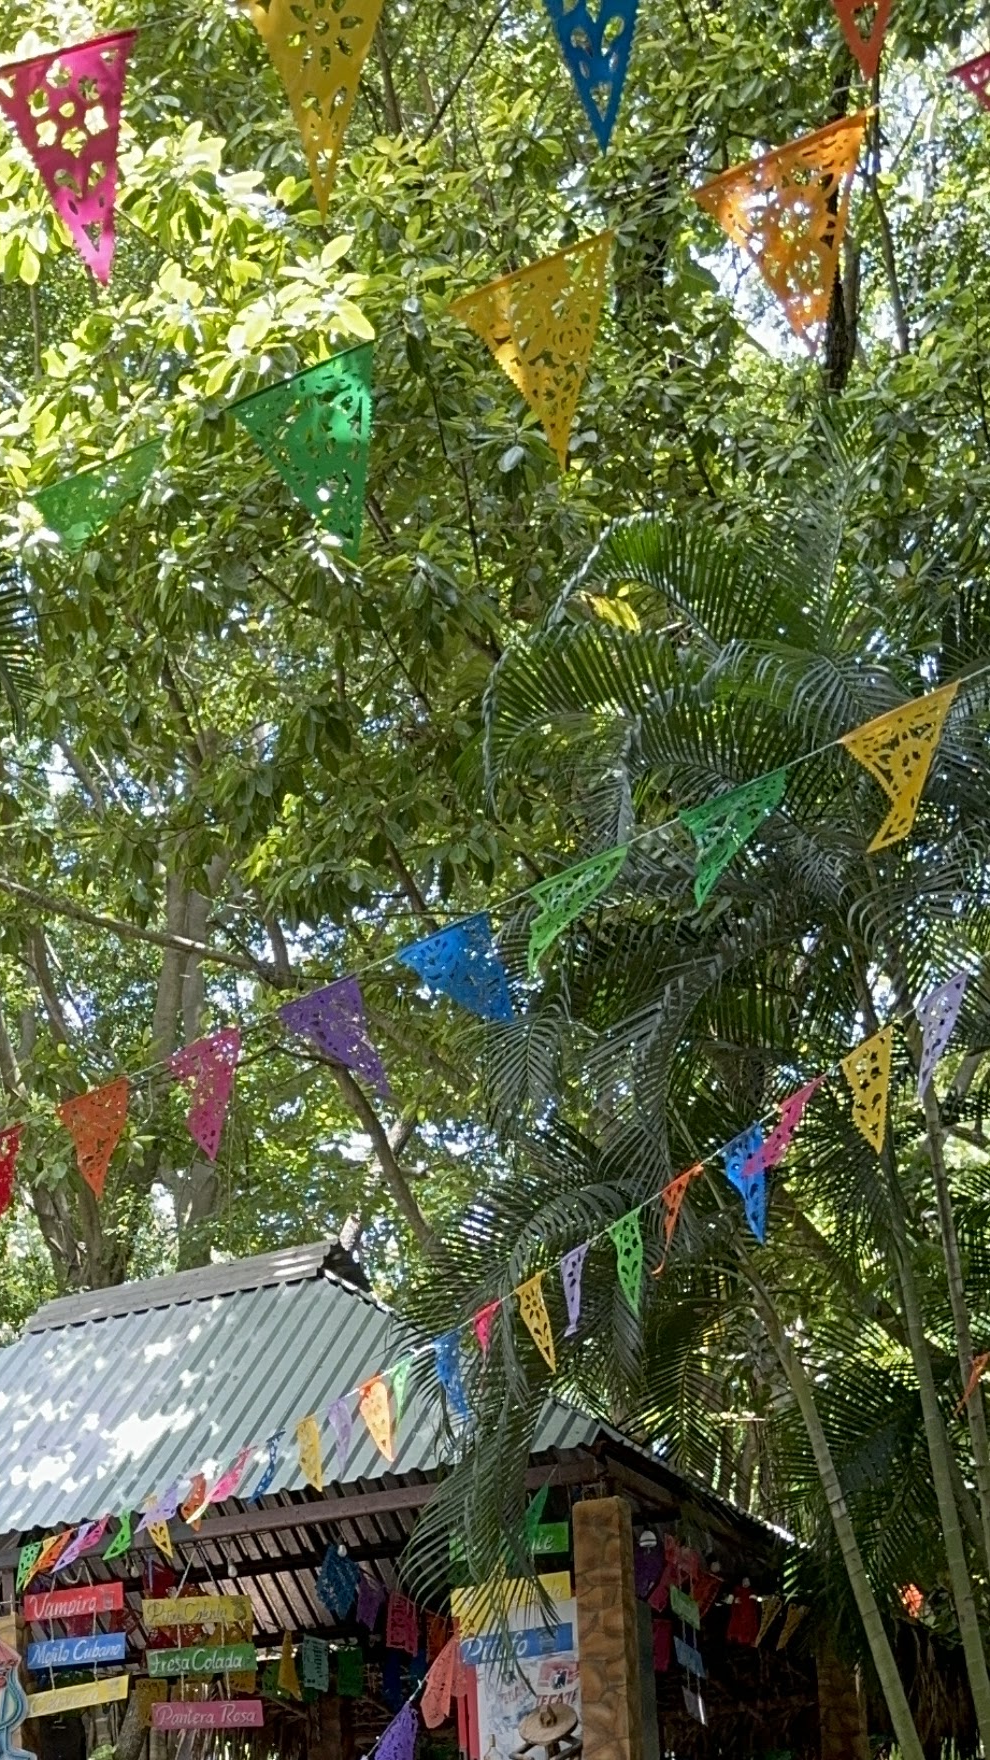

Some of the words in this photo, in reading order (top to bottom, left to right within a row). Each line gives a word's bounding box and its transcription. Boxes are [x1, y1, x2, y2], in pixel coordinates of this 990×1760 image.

[30, 1593, 97, 1619] Vampiro
[29, 1642, 70, 1666] Mojito
[72, 1640, 122, 1660] Cubano
[148, 1650, 190, 1675] Fresa
[192, 1648, 244, 1671] Colada
[156, 1704, 214, 1726] Pantera
[219, 1703, 256, 1723] Rosa
